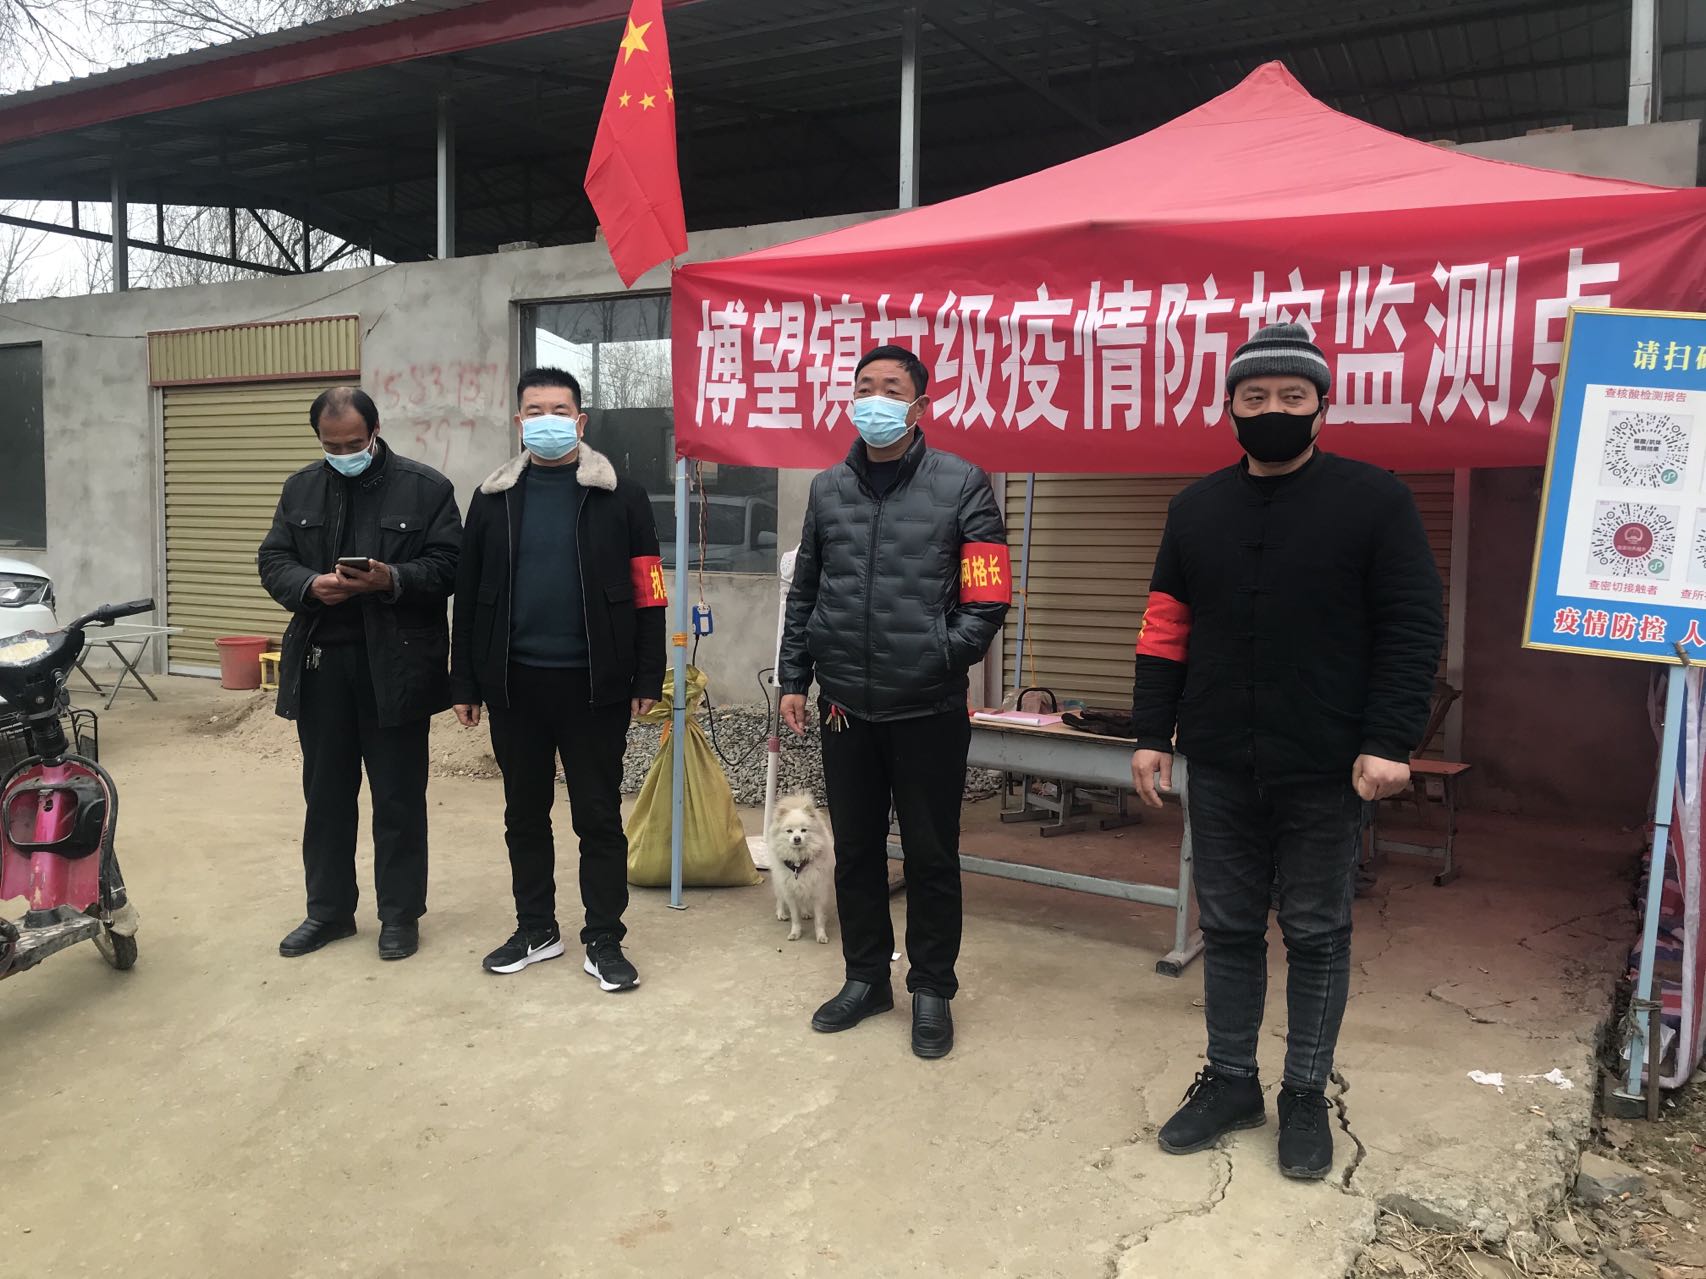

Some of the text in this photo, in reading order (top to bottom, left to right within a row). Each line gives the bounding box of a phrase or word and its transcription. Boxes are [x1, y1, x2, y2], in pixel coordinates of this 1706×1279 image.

[1605, 387, 1687, 403] 查核酸检测报告
[1588, 580, 1658, 595] 查密切接触者
[1680, 588, 1706, 601] 查所
[1553, 607, 1706, 648] 疫情防控 人
